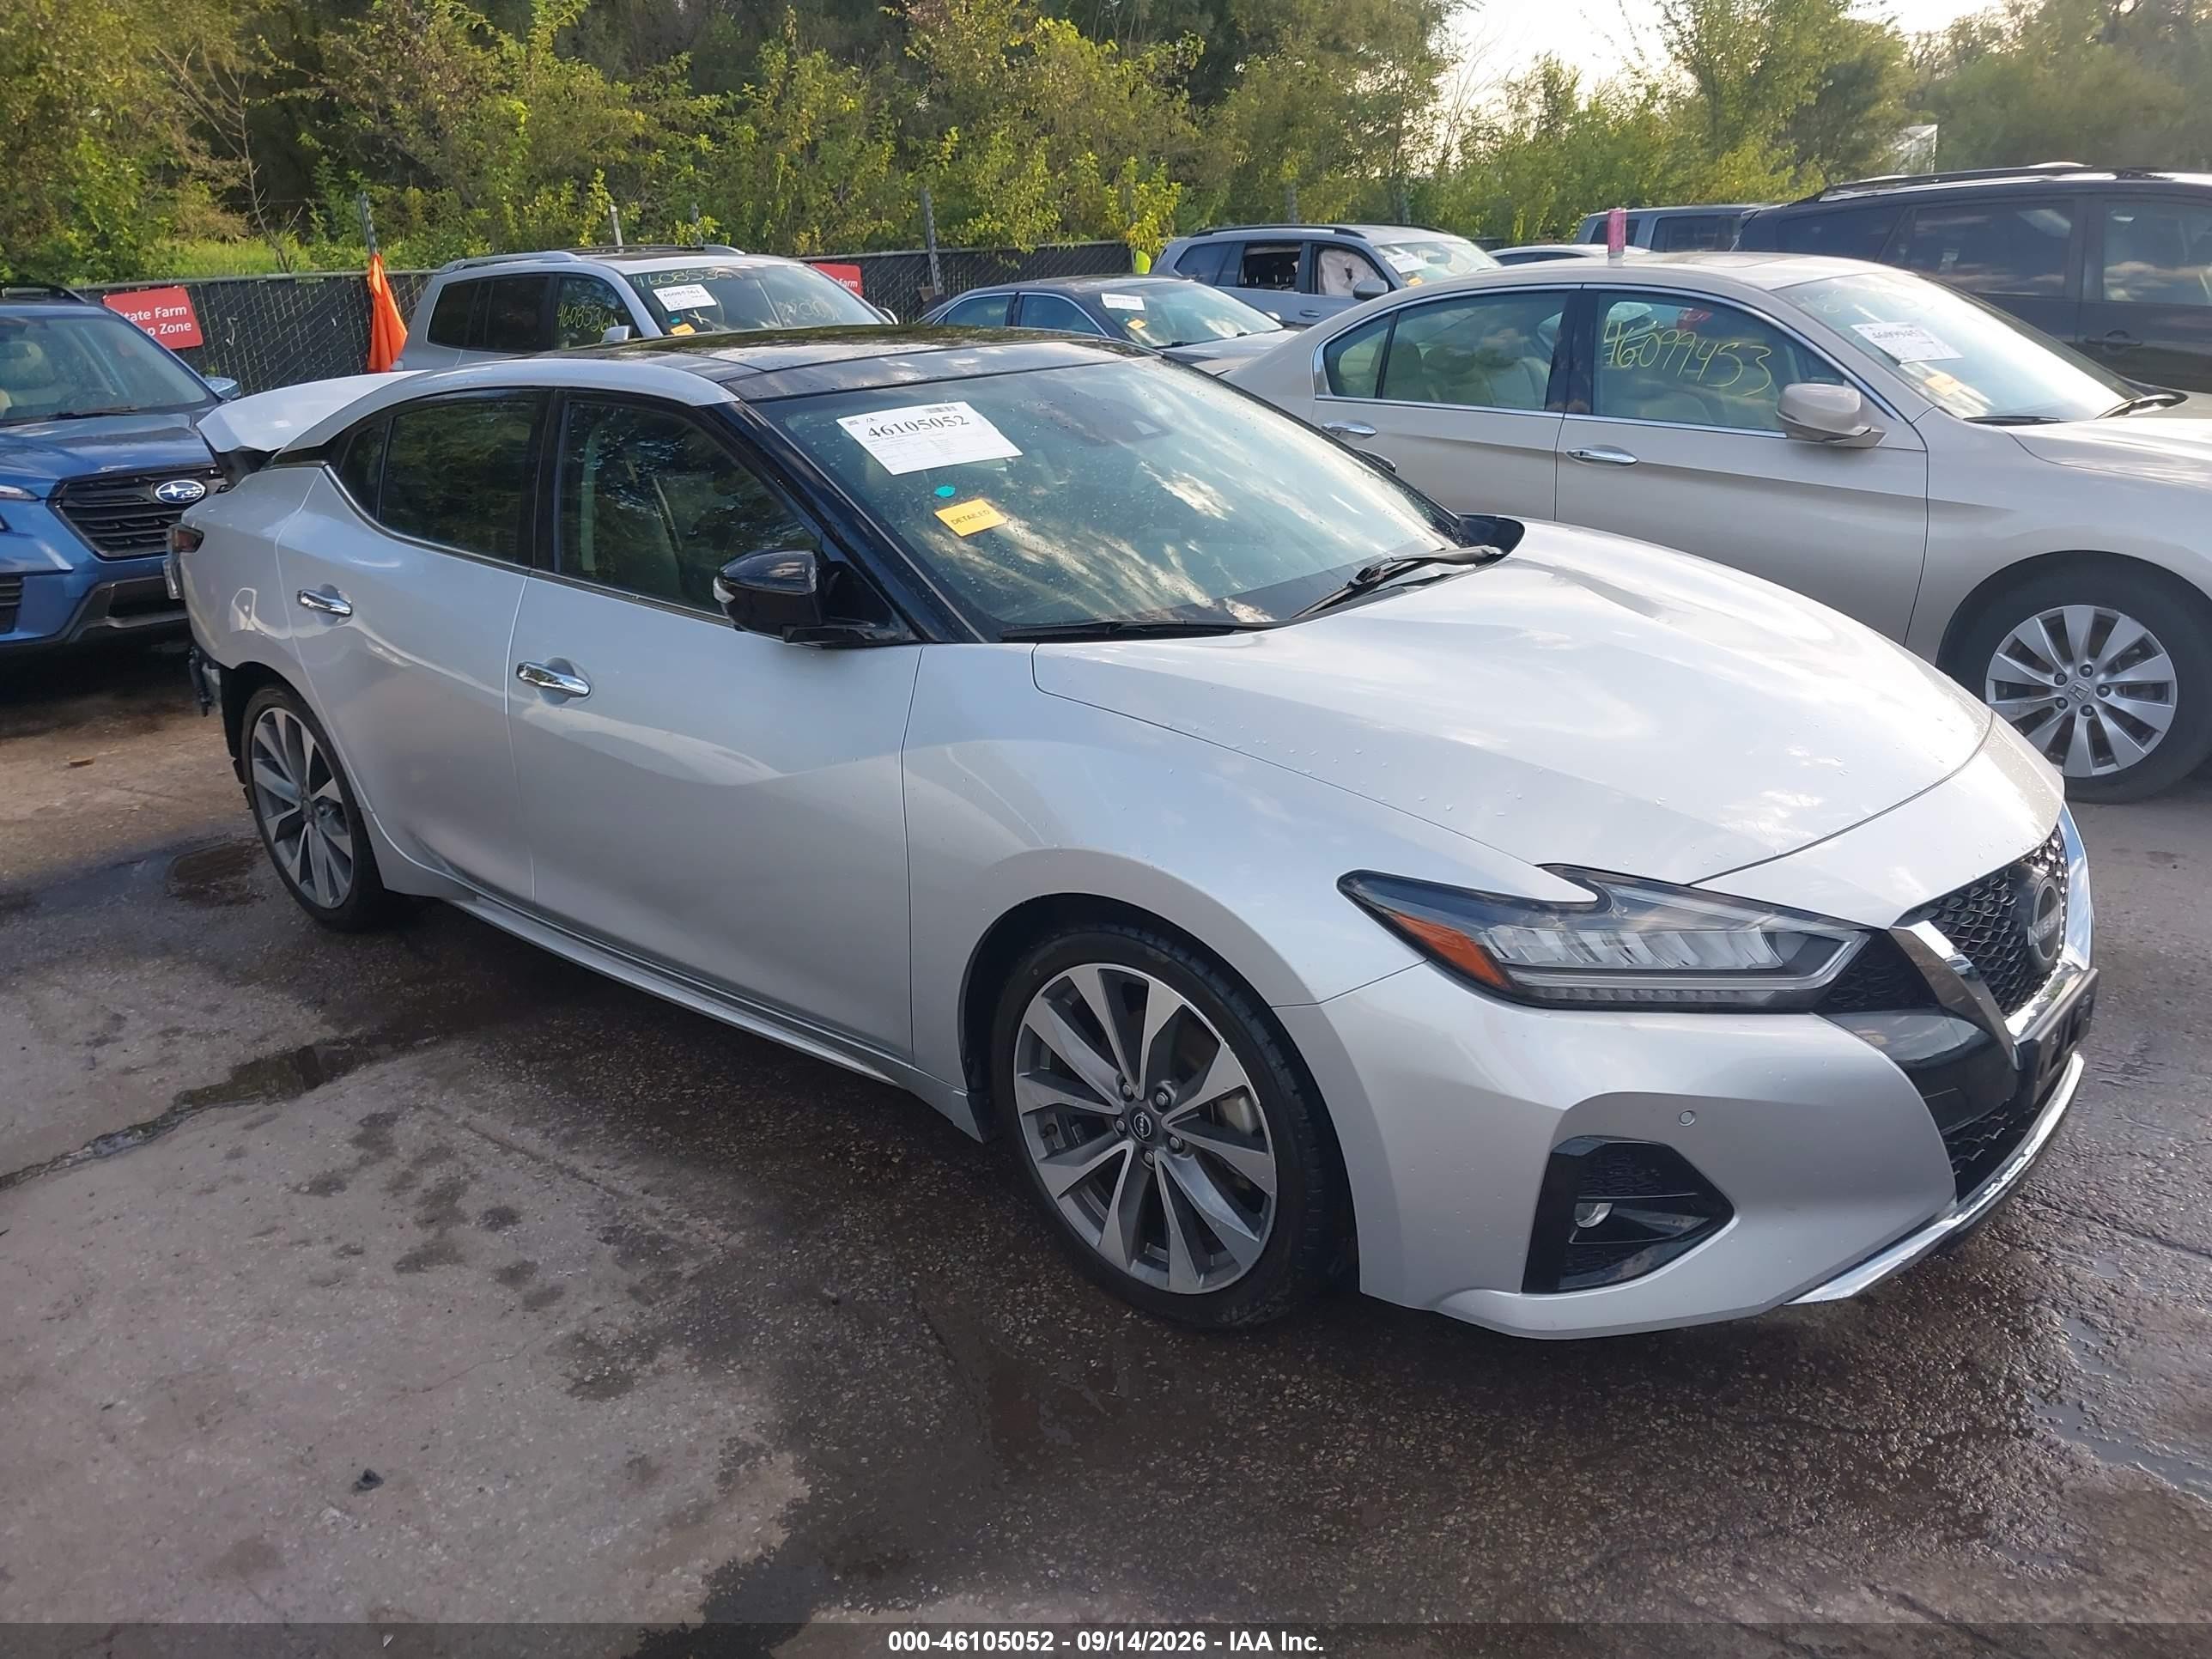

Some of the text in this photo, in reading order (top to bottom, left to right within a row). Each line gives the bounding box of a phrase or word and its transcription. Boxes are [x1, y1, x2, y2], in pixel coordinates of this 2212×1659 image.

[122, 305, 187, 322] tate Farm
[159, 322, 191, 335] Zone
[1603, 321, 1771, 396] 46099453
[868, 415, 970, 439] 46105052
